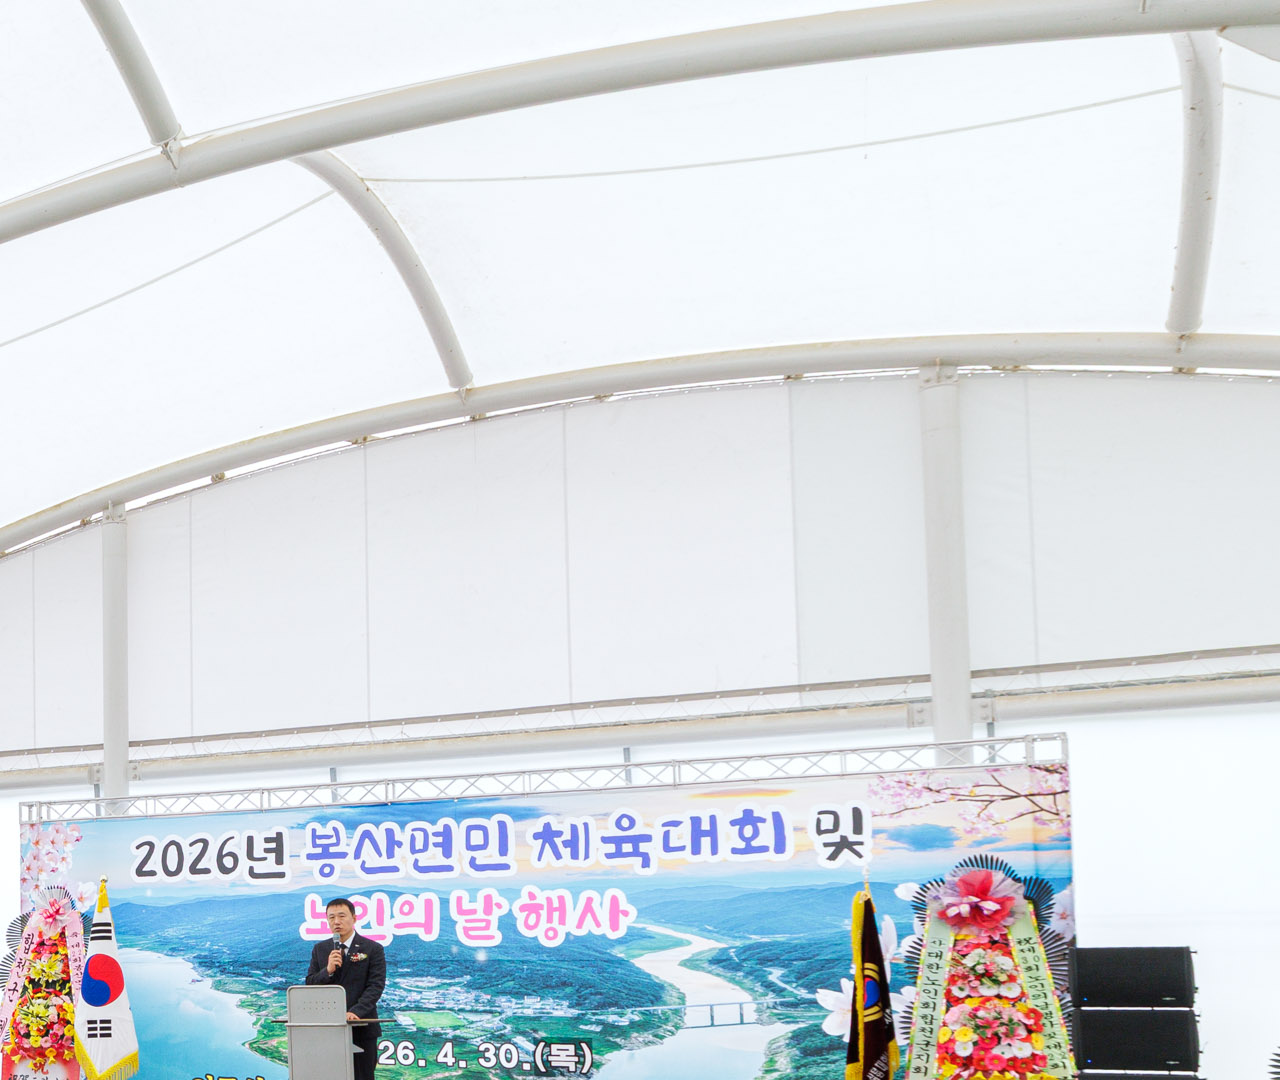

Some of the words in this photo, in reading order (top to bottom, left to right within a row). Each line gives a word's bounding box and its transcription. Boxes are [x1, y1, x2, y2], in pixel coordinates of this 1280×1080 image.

[134, 830, 287, 879] 2026년
[305, 825, 512, 878] 봉산면민
[532, 808, 787, 869] 체육대회
[815, 806, 865, 862] 및
[456, 893, 503, 941] 날
[518, 890, 630, 941] 행사
[435, 1040, 468, 1069] 4.
[477, 1040, 594, 1074] 30.(목)
